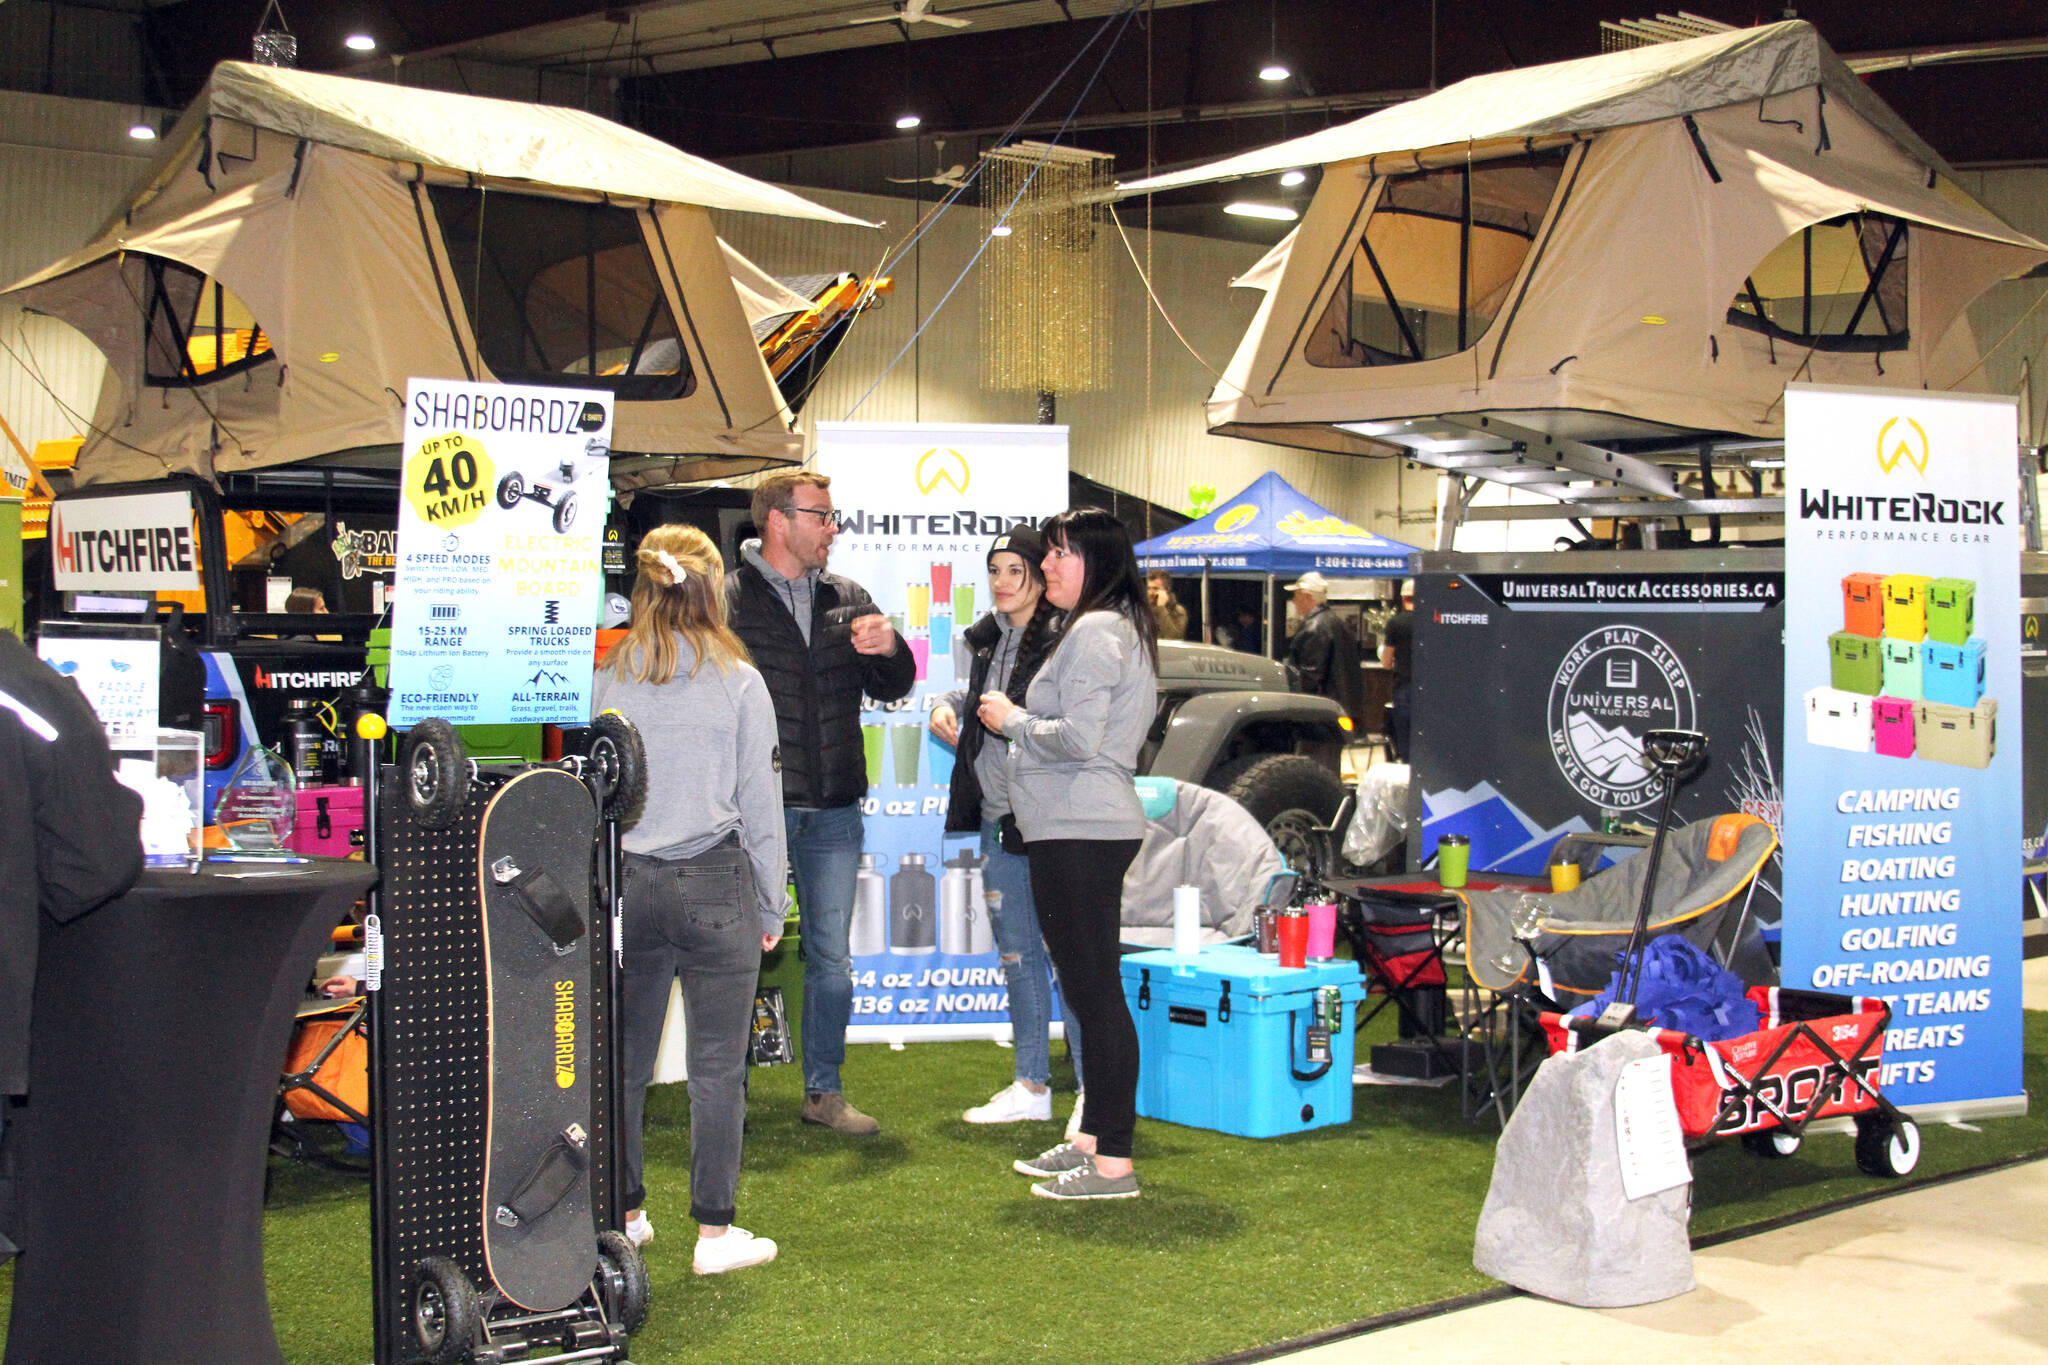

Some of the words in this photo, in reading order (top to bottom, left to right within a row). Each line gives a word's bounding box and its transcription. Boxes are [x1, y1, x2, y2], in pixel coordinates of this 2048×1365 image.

[413, 391, 580, 435] SHABOARDZ
[422, 441, 440, 455] UP
[444, 436, 463, 449] TO
[423, 451, 478, 497] 40
[426, 490, 486, 521] KM/H
[1800, 488, 2004, 525] WHITEROCK
[57, 511, 193, 574] HITCHFIRE
[505, 535, 593, 551] ELECTRIC
[1816, 530, 1940, 543] PERFORMANCE
[1950, 532, 1990, 544] GEAR
[851, 543, 981, 552] PERFORMANCE
[406, 554, 412, 562] 4
[416, 554, 449, 563] SPEED
[452, 555, 491, 564] MODES
[498, 557, 600, 575] MOUNTAIN
[516, 581, 580, 596] BOARD
[1434, 611, 1489, 625] HITCHFIRE
[418, 626, 447, 636] 15-25
[450, 626, 467, 636] KM
[508, 626, 548, 636] SPRING
[551, 626, 592, 636] LOADED
[424, 637, 463, 647] RANGE
[529, 637, 571, 646] TRUCKS
[542, 658, 568, 666] surface
[1557, 642, 1591, 686] WORK
[1604, 630, 1640, 645] PLAY
[1651, 644, 1686, 689] SLEEP
[255, 667, 362, 690] HITCHFIRE
[400, 692, 480, 703] ECO-FRIENDLY
[511, 692, 580, 701] ALL-TERRAIN
[510, 715, 544, 723] roadways
[1593, 708, 1629, 716] TRUCK
[1579, 777, 1608, 801] GOT
[1612, 791, 1641, 805] YOU
[1837, 788, 1960, 813] CAMPING
[1847, 822, 1952, 848] FISHING
[1841, 856, 1956, 882] BOATING
[1840, 890, 1961, 917] HUNTING
[1841, 924, 1957, 951] GOLFING
[917, 968, 1008, 987] JOURN
[1812, 956, 1991, 988] OFF-ROADING
[852, 996, 894, 1014] 136
[899, 998, 930, 1013] oz
[1903, 989, 1991, 1016] TEAMS
[554, 980, 575, 1075] SHABOARDZ
[1832, 1024, 1859, 1041] 354
[1883, 1024, 1966, 1051] REATS
[1879, 1060, 1936, 1086] IFTS
